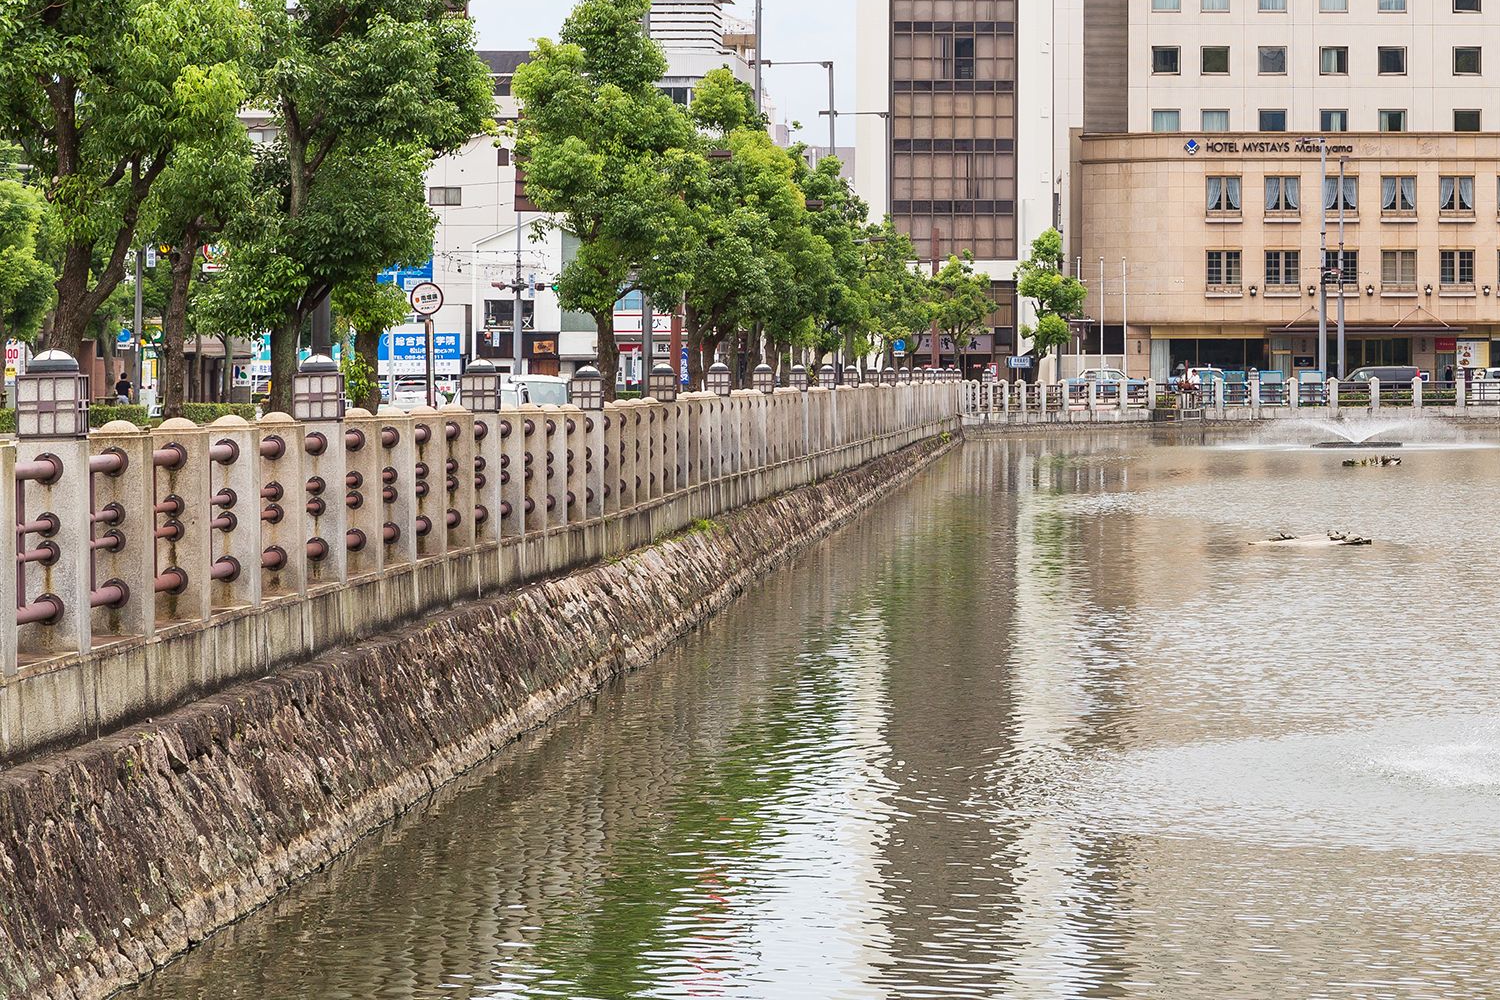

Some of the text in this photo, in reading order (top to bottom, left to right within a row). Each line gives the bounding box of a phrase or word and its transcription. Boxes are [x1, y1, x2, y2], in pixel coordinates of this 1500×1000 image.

[1206, 142, 1353, 155] HOTEL MYSTAYS Matsyama
[395, 335, 455, 347] 総合資学院
